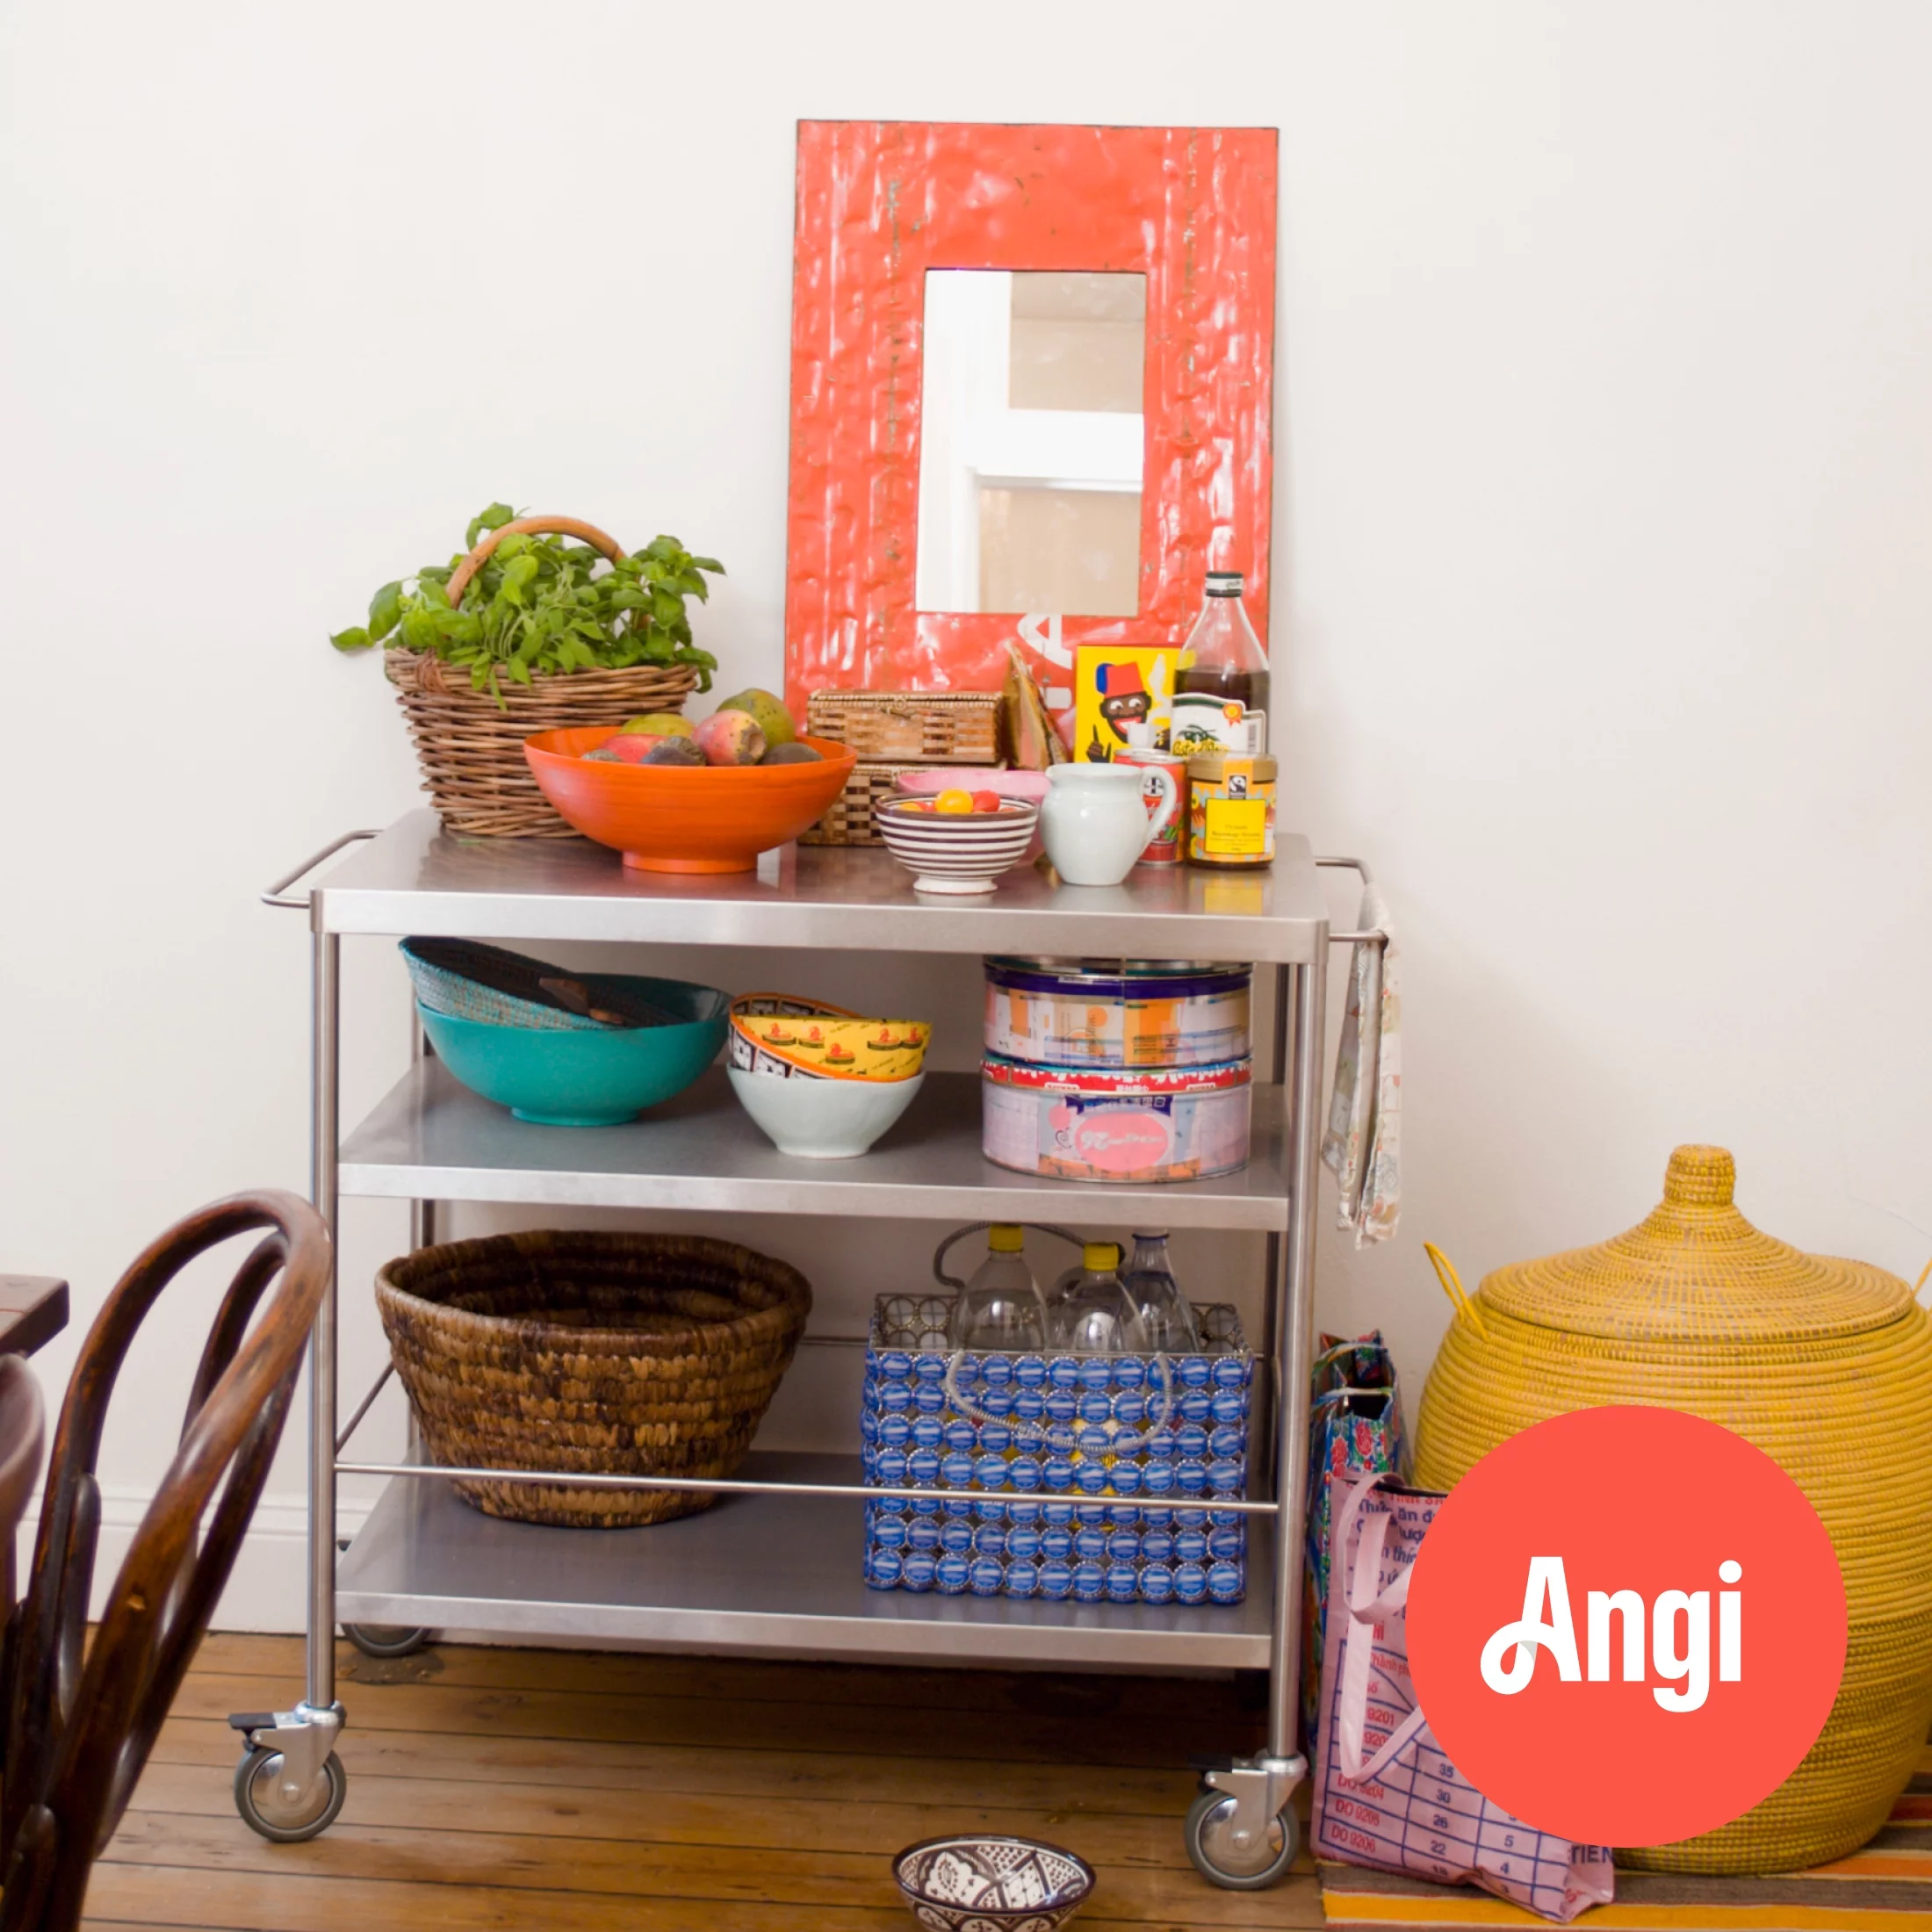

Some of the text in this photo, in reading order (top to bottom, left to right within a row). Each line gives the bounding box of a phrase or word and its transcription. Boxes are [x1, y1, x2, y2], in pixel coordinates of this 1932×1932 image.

[1440, 1763, 1454, 1778] 35
[1436, 1788, 1452, 1804] 30
[1335, 1798, 1354, 1817] DO
[1330, 1824, 1349, 1842] DO
[1430, 1840, 1447, 1856] 22
